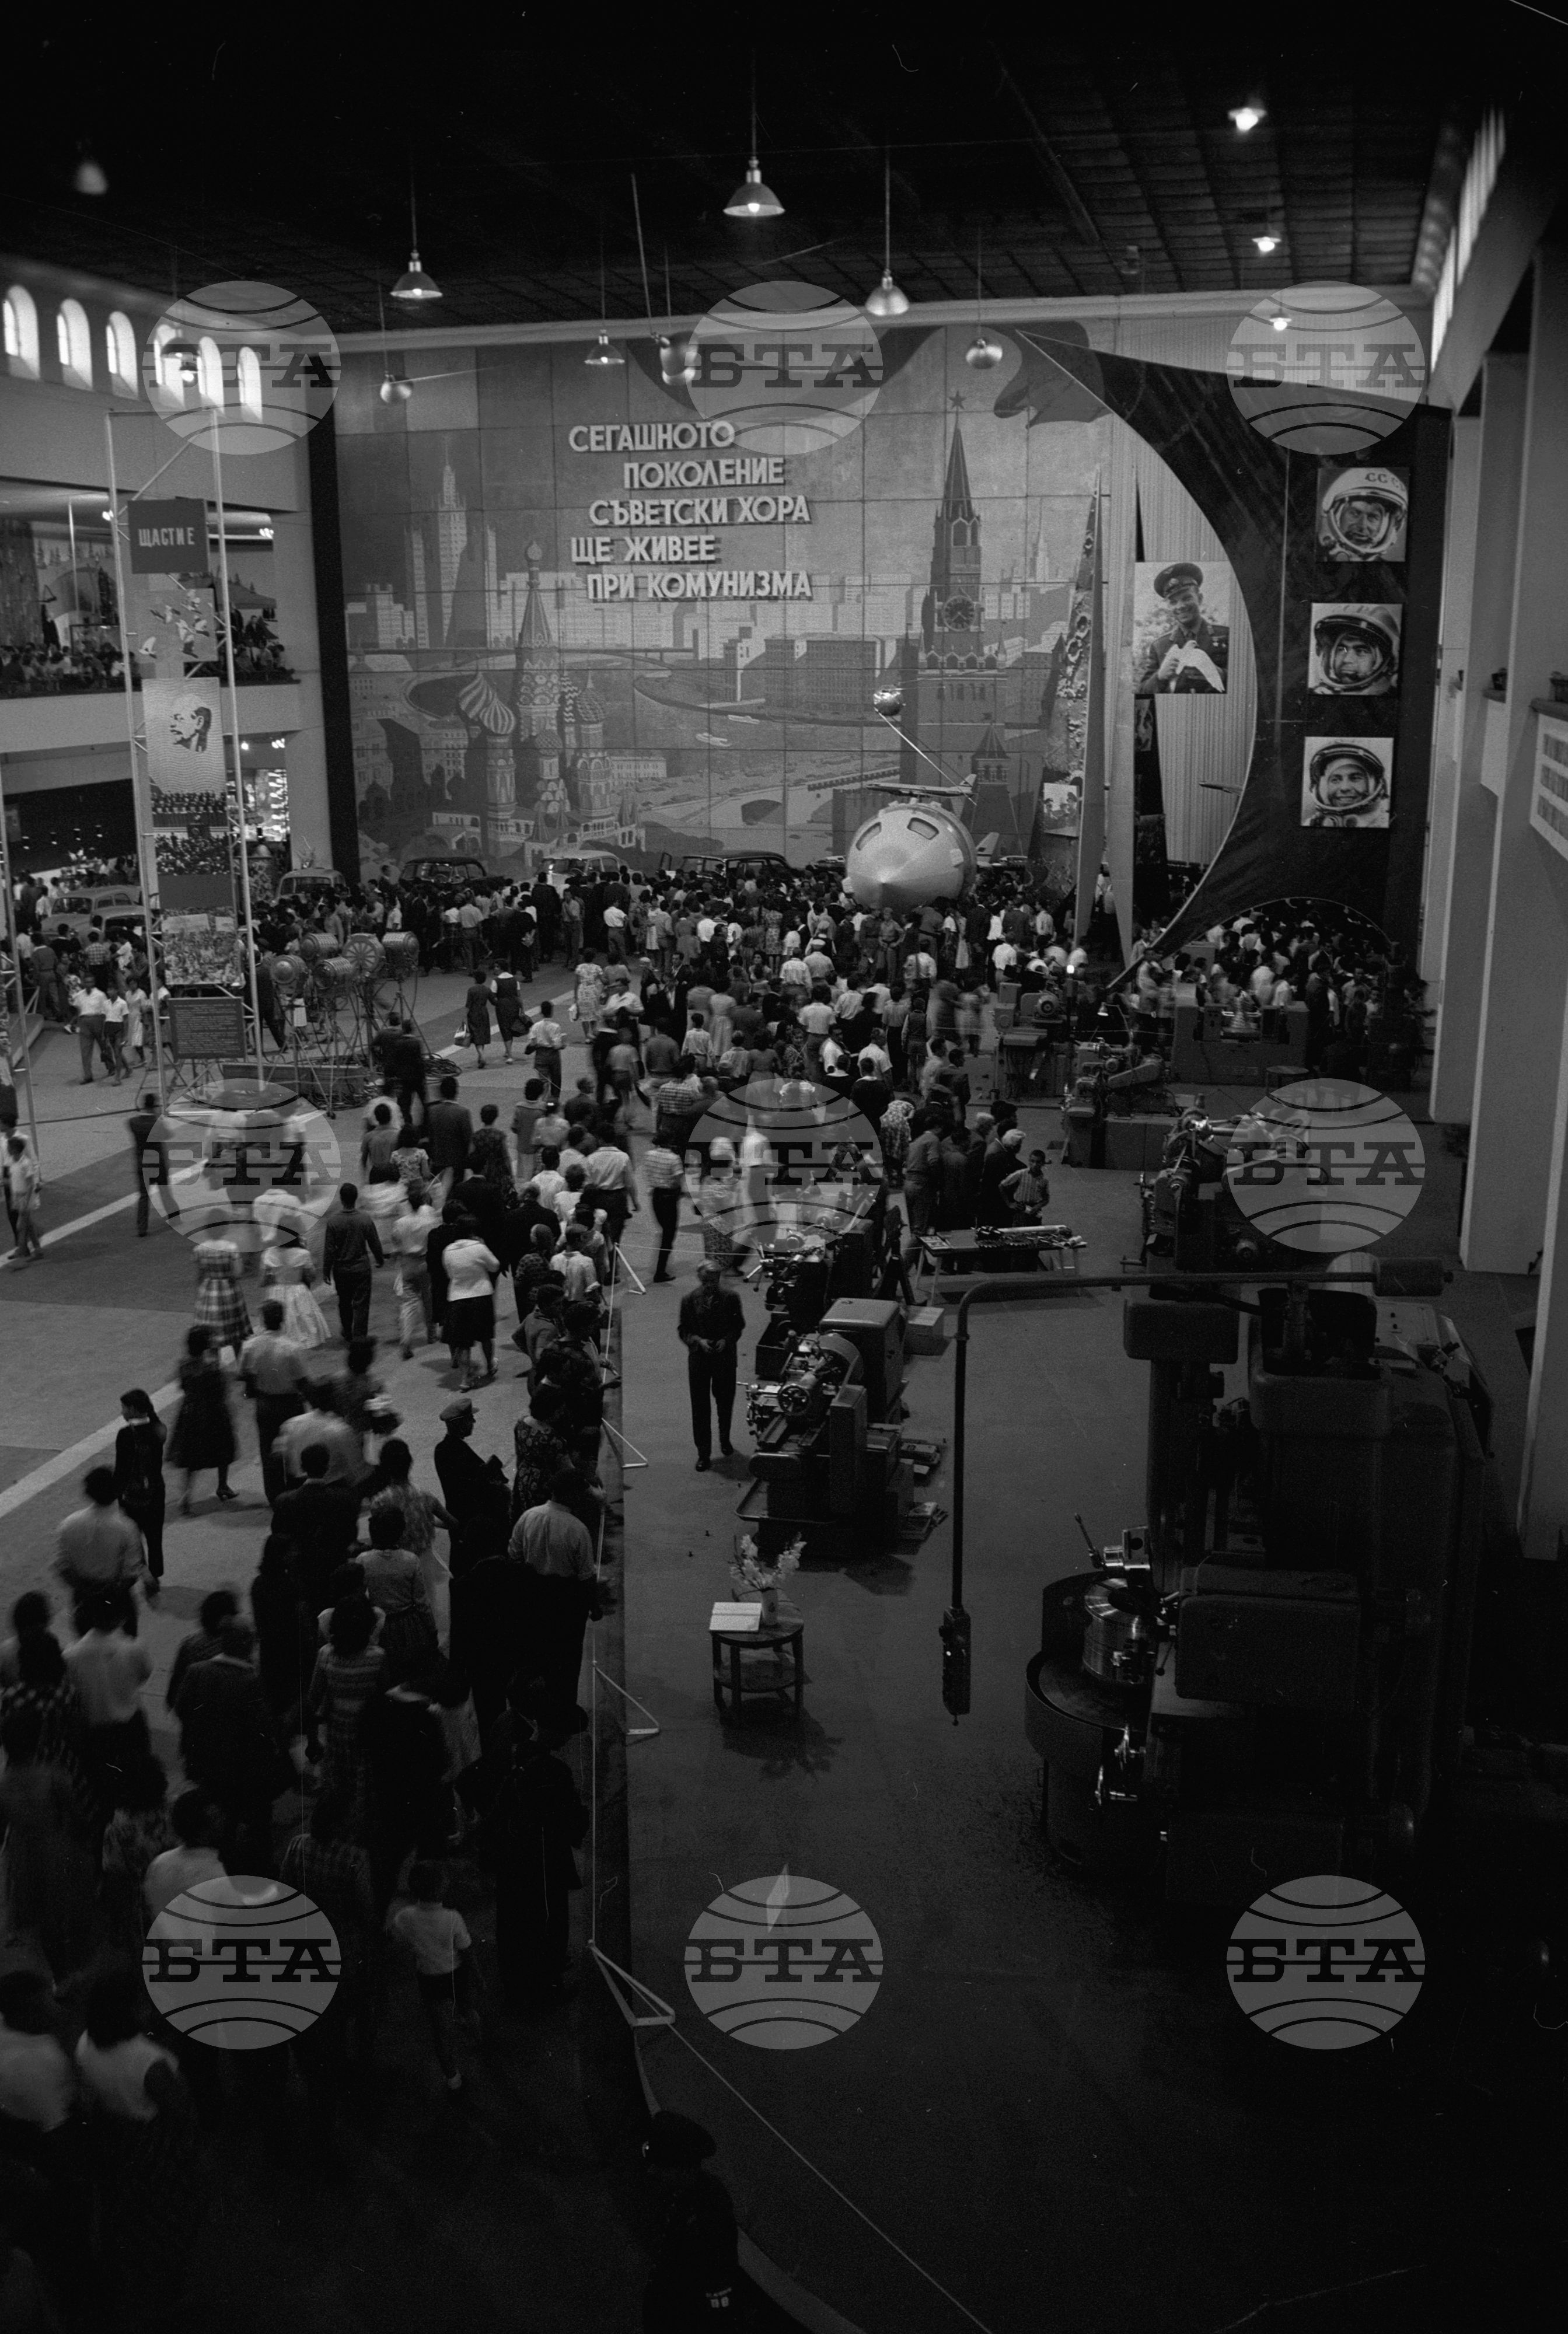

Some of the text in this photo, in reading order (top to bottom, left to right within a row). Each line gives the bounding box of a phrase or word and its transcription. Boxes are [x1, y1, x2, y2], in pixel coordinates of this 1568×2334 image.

[568, 420, 735, 452] СЕГАШНОТО
[624, 457, 784, 489] ПОКОЛЕНИЕ
[589, 495, 811, 525] СЪВЕТСКИ ХОРА
[138, 527, 195, 547] ЩАСТИЕ
[571, 534, 716, 565] ЩЕ ЖИВЕЕ
[588, 570, 811, 599] ПРИ КОМУНИЗМА
